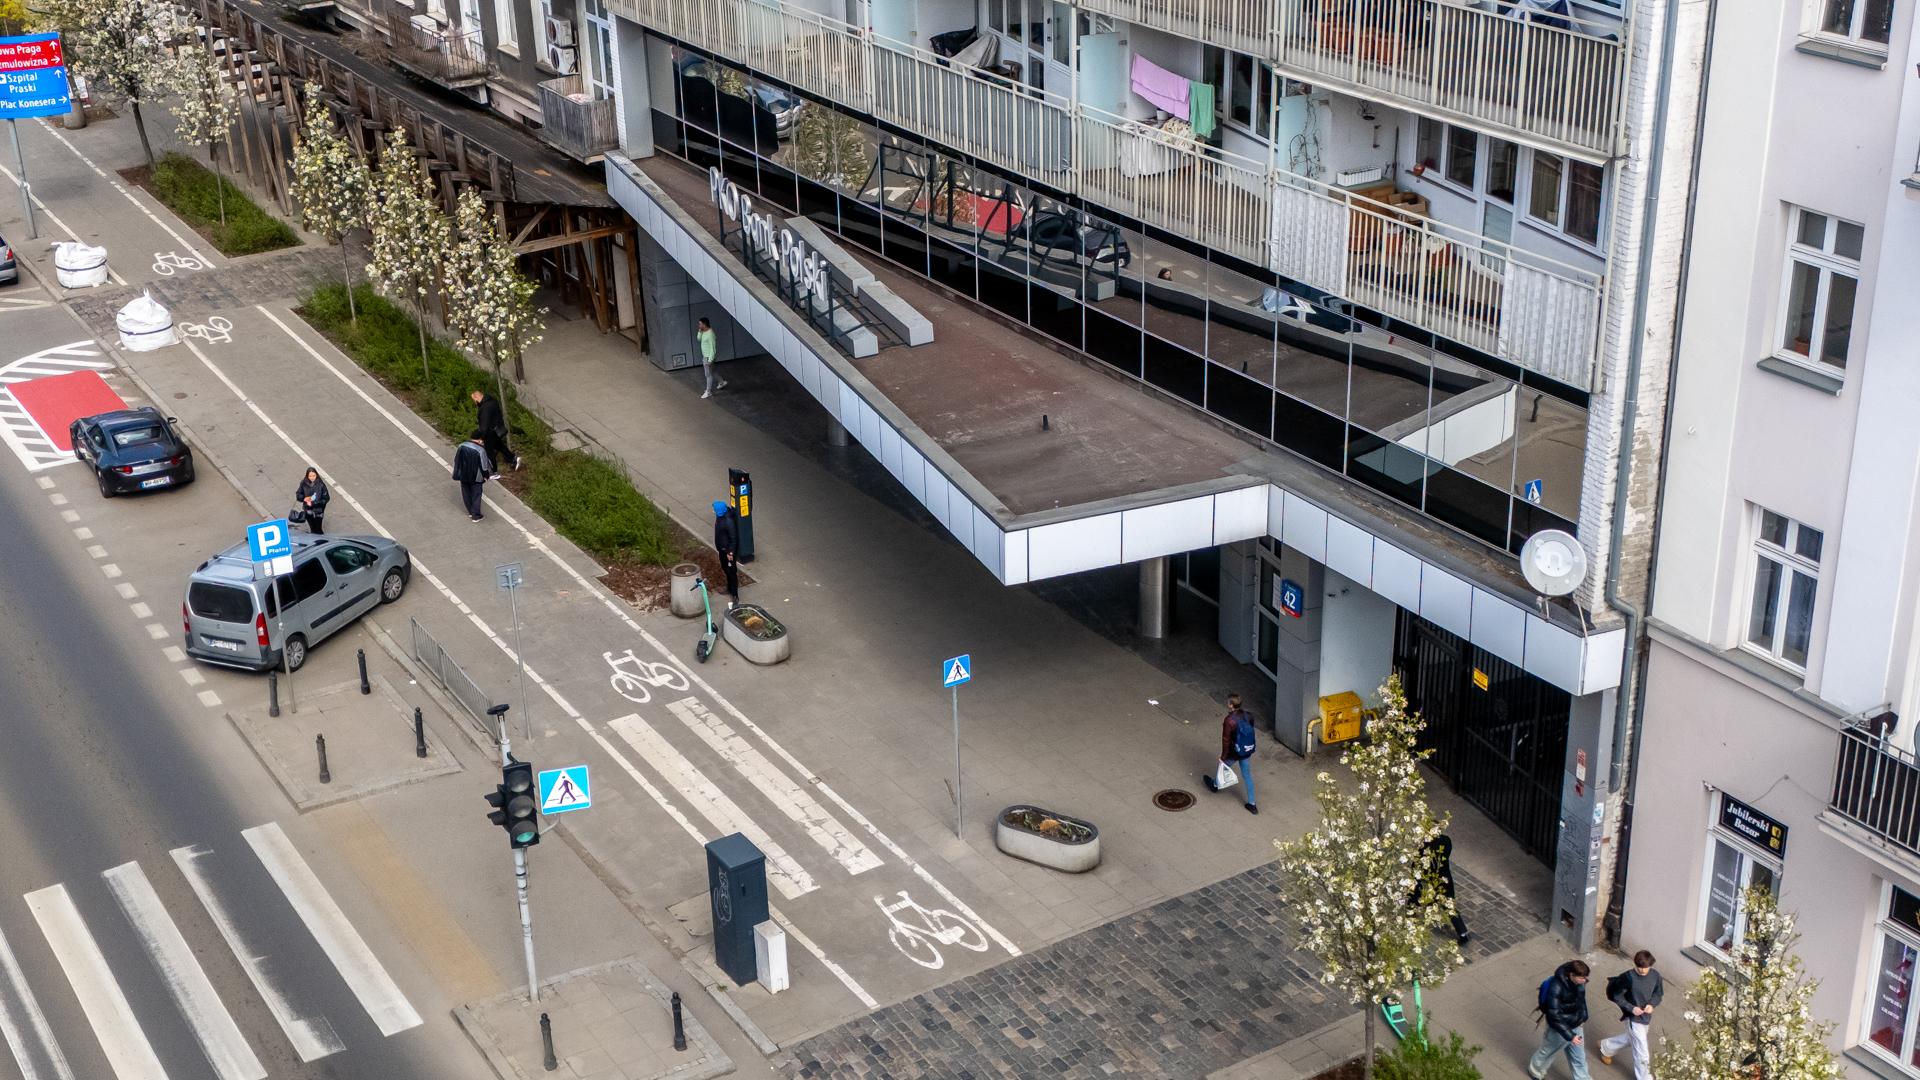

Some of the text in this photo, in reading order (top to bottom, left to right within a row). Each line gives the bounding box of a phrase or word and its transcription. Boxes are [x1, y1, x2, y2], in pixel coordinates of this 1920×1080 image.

[16, 45, 42, 56] Praga
[7, 71, 38, 84] Szpital
[9, 82, 37, 93] Praski
[0, 98, 56, 109] Plac Konesera
[710, 166, 827, 302] PKO Bank Polski
[257, 524, 281, 557] P
[1284, 590, 1296, 609] 42
[1727, 803, 1769, 832] Jubilerski
[1734, 818, 1760, 838] Bazar
